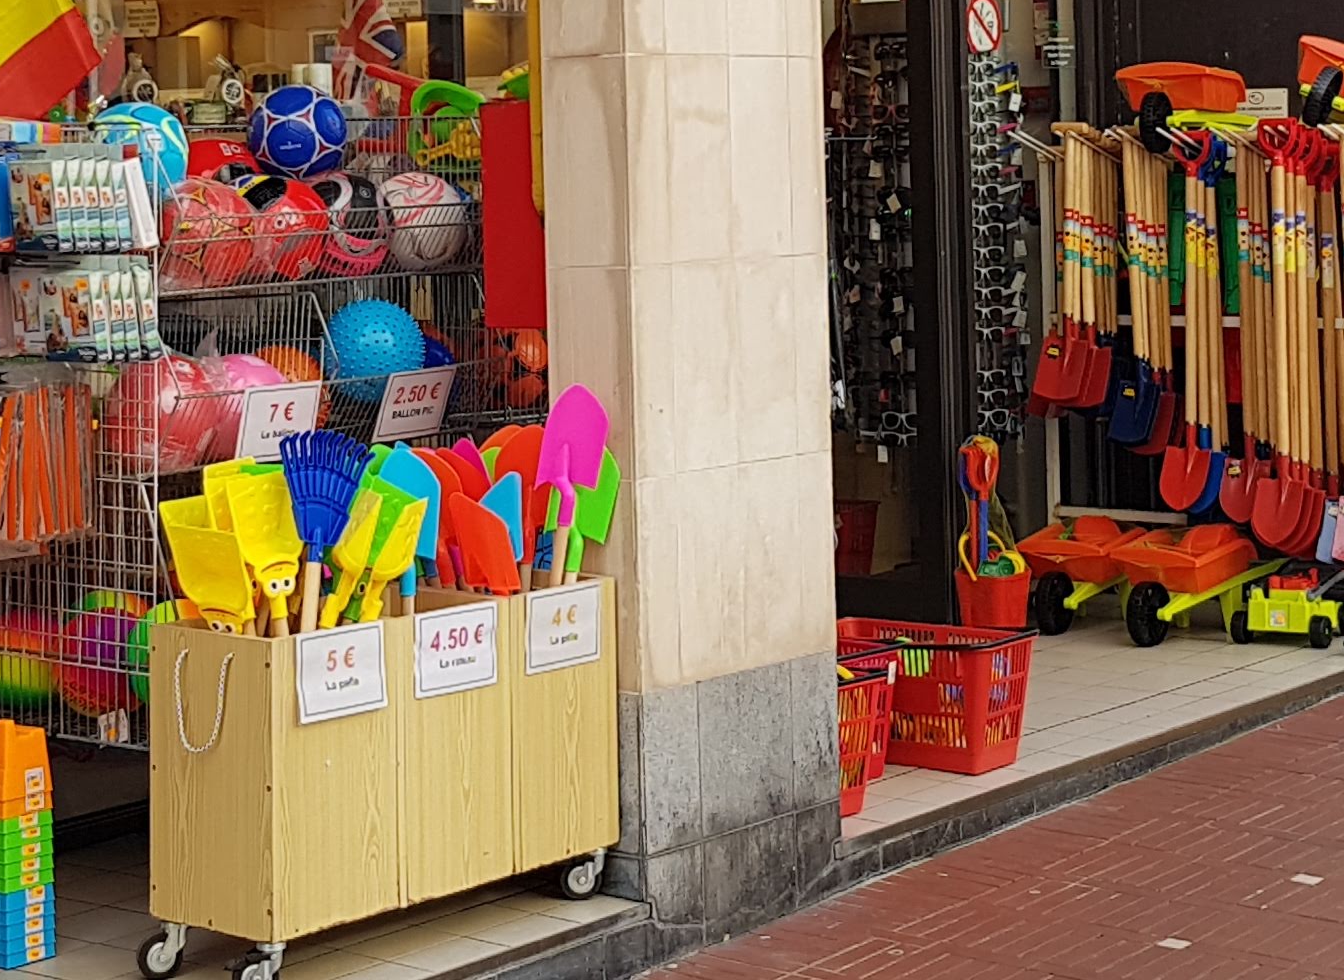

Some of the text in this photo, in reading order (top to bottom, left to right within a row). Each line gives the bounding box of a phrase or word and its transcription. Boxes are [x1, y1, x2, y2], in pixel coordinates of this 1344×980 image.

[393, 382, 443, 405] 2.50 €
[269, 401, 296, 423] 7 €
[551, 605, 578, 628] 4 €
[429, 623, 485, 652] 4.50 €
[326, 645, 356, 672] 5 €
